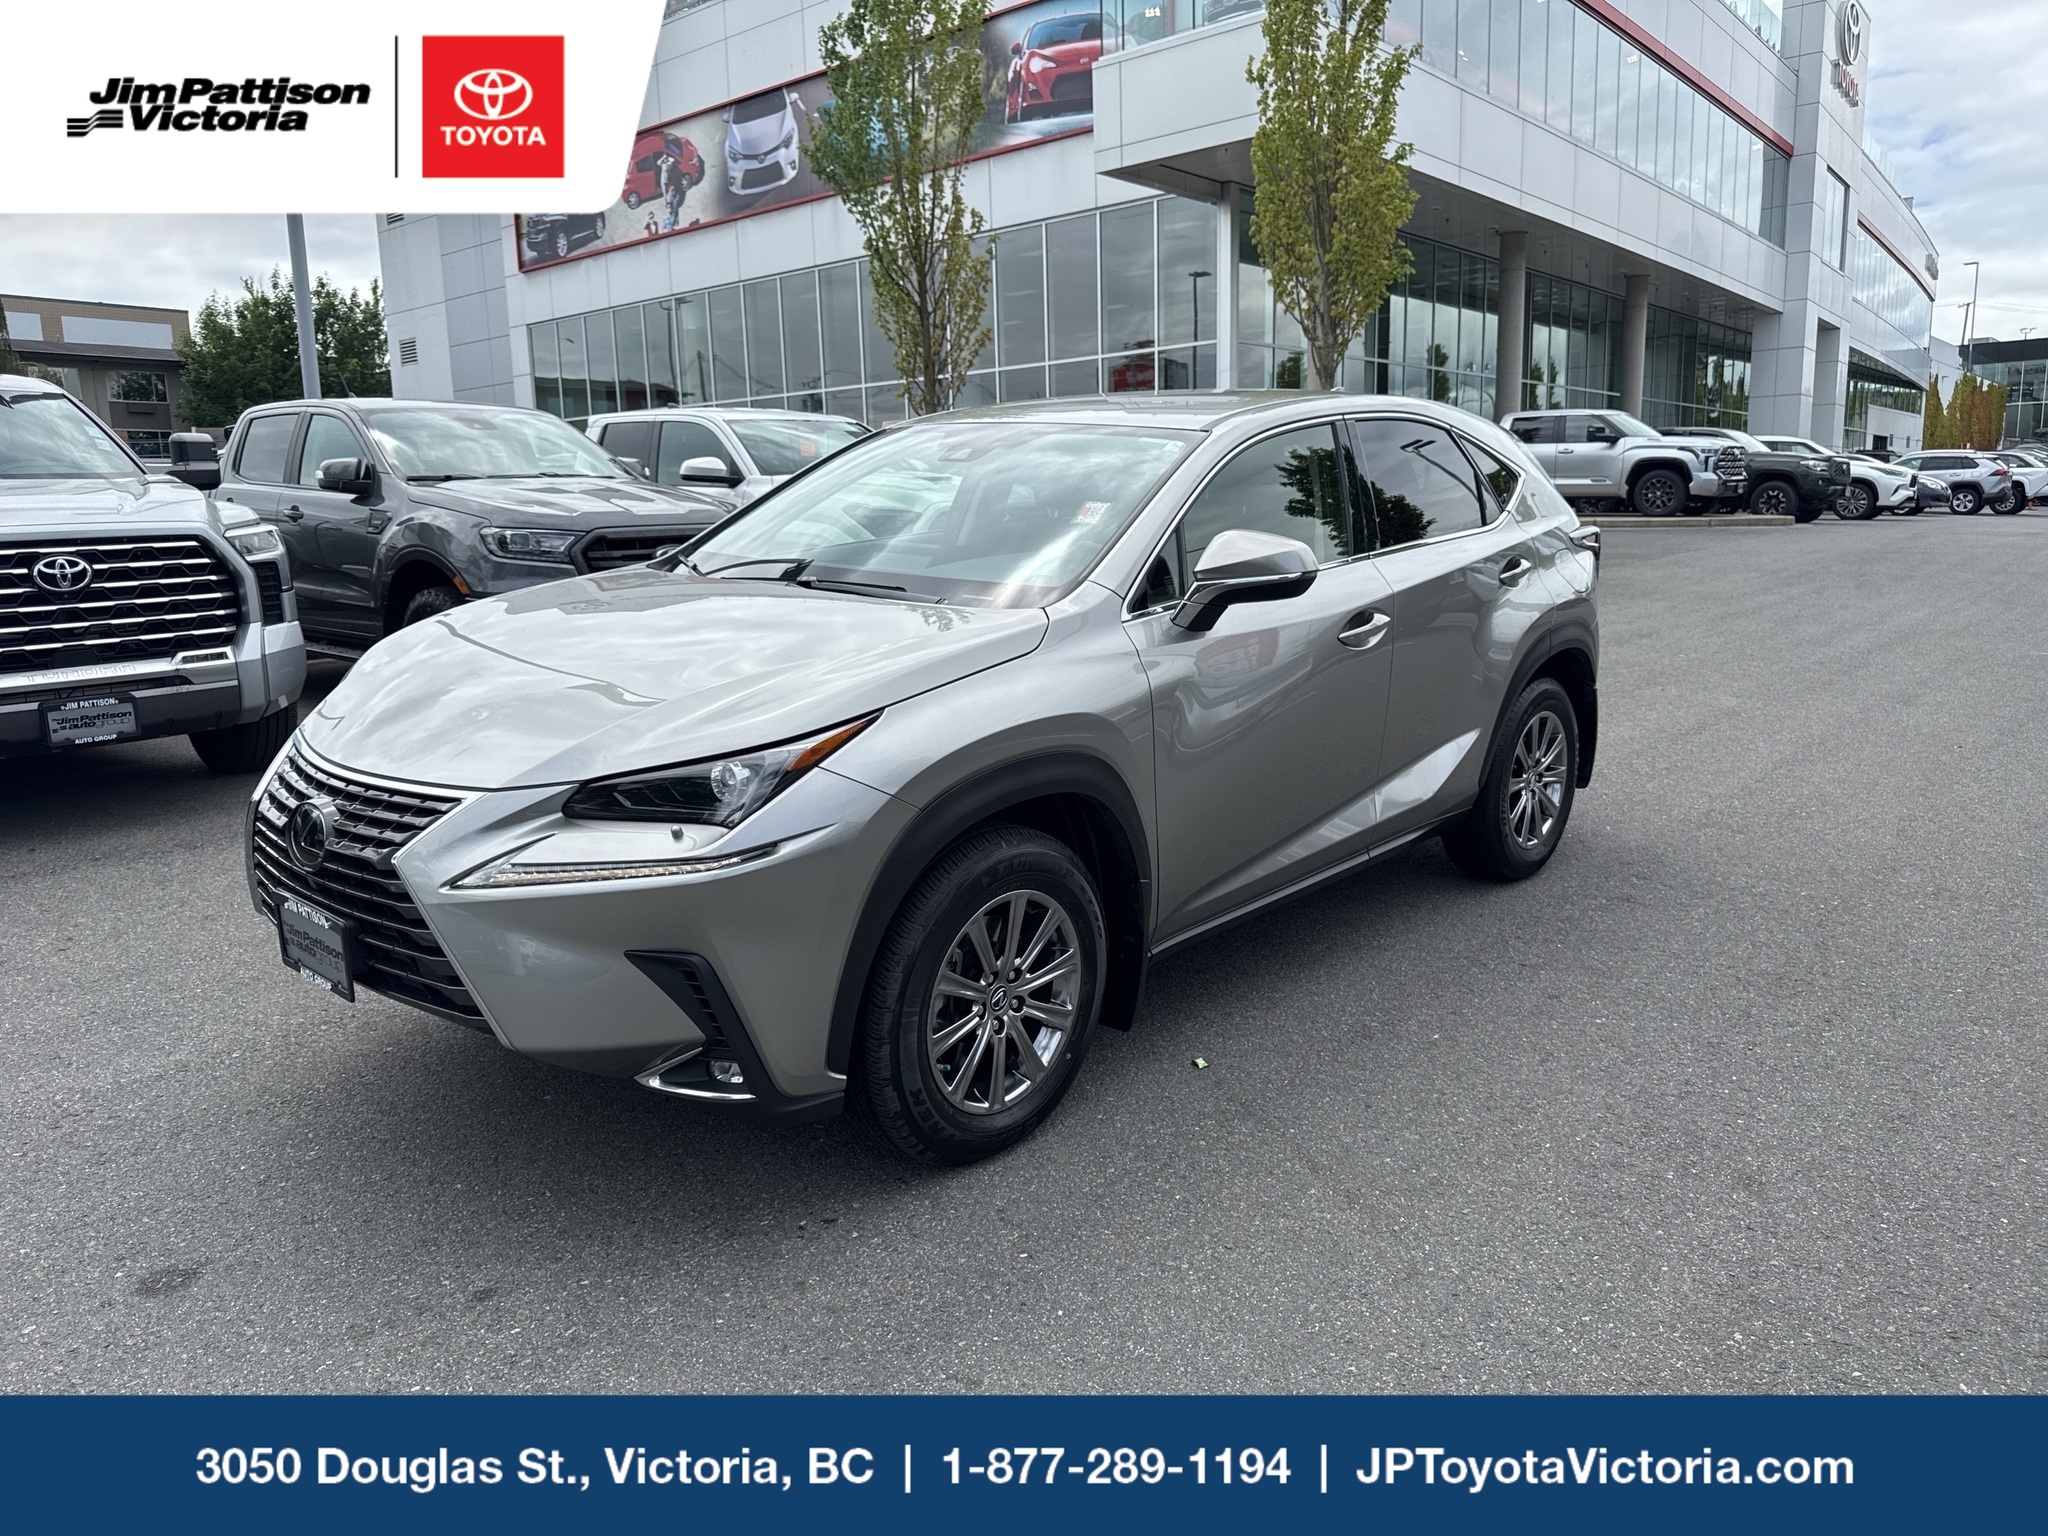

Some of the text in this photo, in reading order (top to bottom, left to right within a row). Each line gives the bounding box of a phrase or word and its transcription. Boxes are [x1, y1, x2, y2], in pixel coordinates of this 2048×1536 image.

[21, 664, 137, 682] TUNDRA
[64, 698, 115, 710] JIM PATTISON
[94, 734, 117, 742] GROUP
[288, 899, 298, 913] JIM
[298, 903, 328, 926] PATTISON
[301, 965, 331, 990] AUTO GROUP
